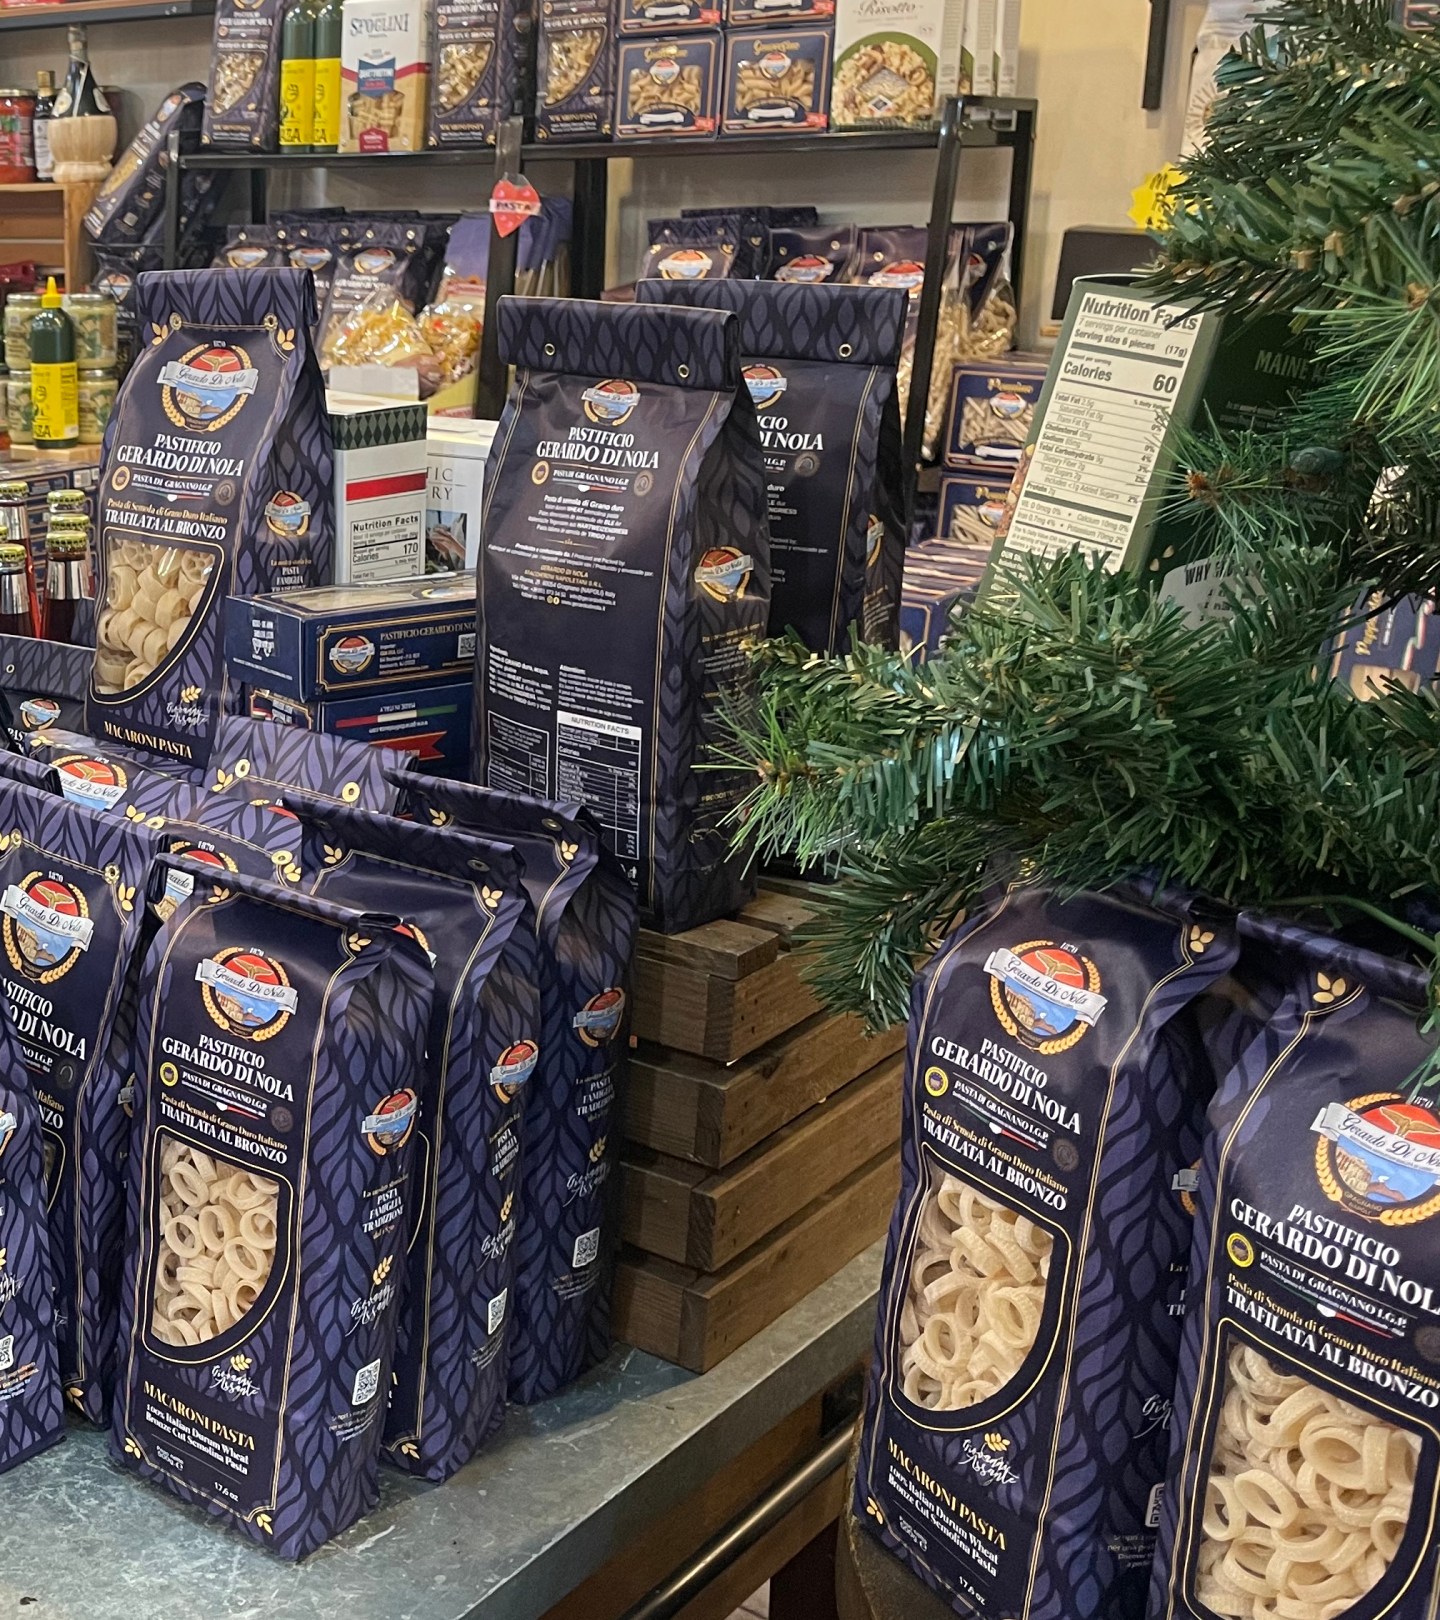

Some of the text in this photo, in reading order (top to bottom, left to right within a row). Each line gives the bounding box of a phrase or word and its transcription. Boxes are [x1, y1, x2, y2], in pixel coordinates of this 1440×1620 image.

[496, 202, 532, 210] PASTA
[1083, 296, 1150, 323] Nutrition
[1074, 329, 1100, 343] Serving
[1101, 334, 1120, 345] size
[1130, 339, 1155, 352] pieces
[1079, 317, 1162, 339] 7 servings per container
[1165, 344, 1187, 358] (17g)
[1254, 350, 1308, 380] MAINE
[1064, 361, 1113, 381] Calories
[1152, 374, 1177, 393] 60
[154, 433, 221, 455] PASTIFICIO
[568, 427, 634, 448] PASTIFICIO
[117, 445, 244, 477] GERARDO DI NOLA
[536, 441, 659, 469] GERARDO DI NOLA
[1027, 483, 1047, 493] Protein
[105, 509, 226, 540] TRAFILATA AL BRONZO
[353, 515, 418, 531] Nutrition Facts
[353, 552, 379, 563] Calories
[403, 543, 418, 554] 170
[1185, 563, 1211, 586] WHY
[571, 716, 630, 735] NUTRITION FACTS
[104, 721, 192, 759] MACARONI PASTA
[76, 782, 119, 798] Di Nola
[197, 841, 215, 851] 1870
[18, 1015, 86, 1061] DI NOLA
[198, 1034, 265, 1069] PASTIFICIO
[162, 1037, 294, 1102] GERARDO DI NOLA
[980, 1037, 1047, 1089] PASTIFICIO
[931, 1036, 1081, 1135] GERARDO DI NOLA
[160, 1101, 288, 1165] TRAFILATA AL BRONZO
[922, 1114, 1067, 1211] TRAFILATA AL BRONZO
[369, 1197, 402, 1221] FAMIGLIA
[377, 1187, 398, 1204] PASTA
[362, 1207, 404, 1234] TRADIZIONE
[1230, 1198, 1343, 1270] GERARDO
[1345, 1253, 1378, 1287] DI
[1286, 1204, 1400, 1268] PASTIFICIO
[1226, 1284, 1439, 1409] TRAFILATA AL BRONZO
[143, 1381, 255, 1451] MACARONI PASTA
[146, 1411, 248, 1475] Bronze Cut Semolina Pasta
[147, 1403, 249, 1465] 100% Italian Durum Wheat
[887, 1437, 1006, 1550] MACARONI PASTA
[888, 1472, 997, 1577] Bronze Cut Semolina Pasta
[908, 1480, 935, 1513] Italian
[936, 1504, 967, 1536] Durum
[969, 1531, 999, 1565] Wheat
